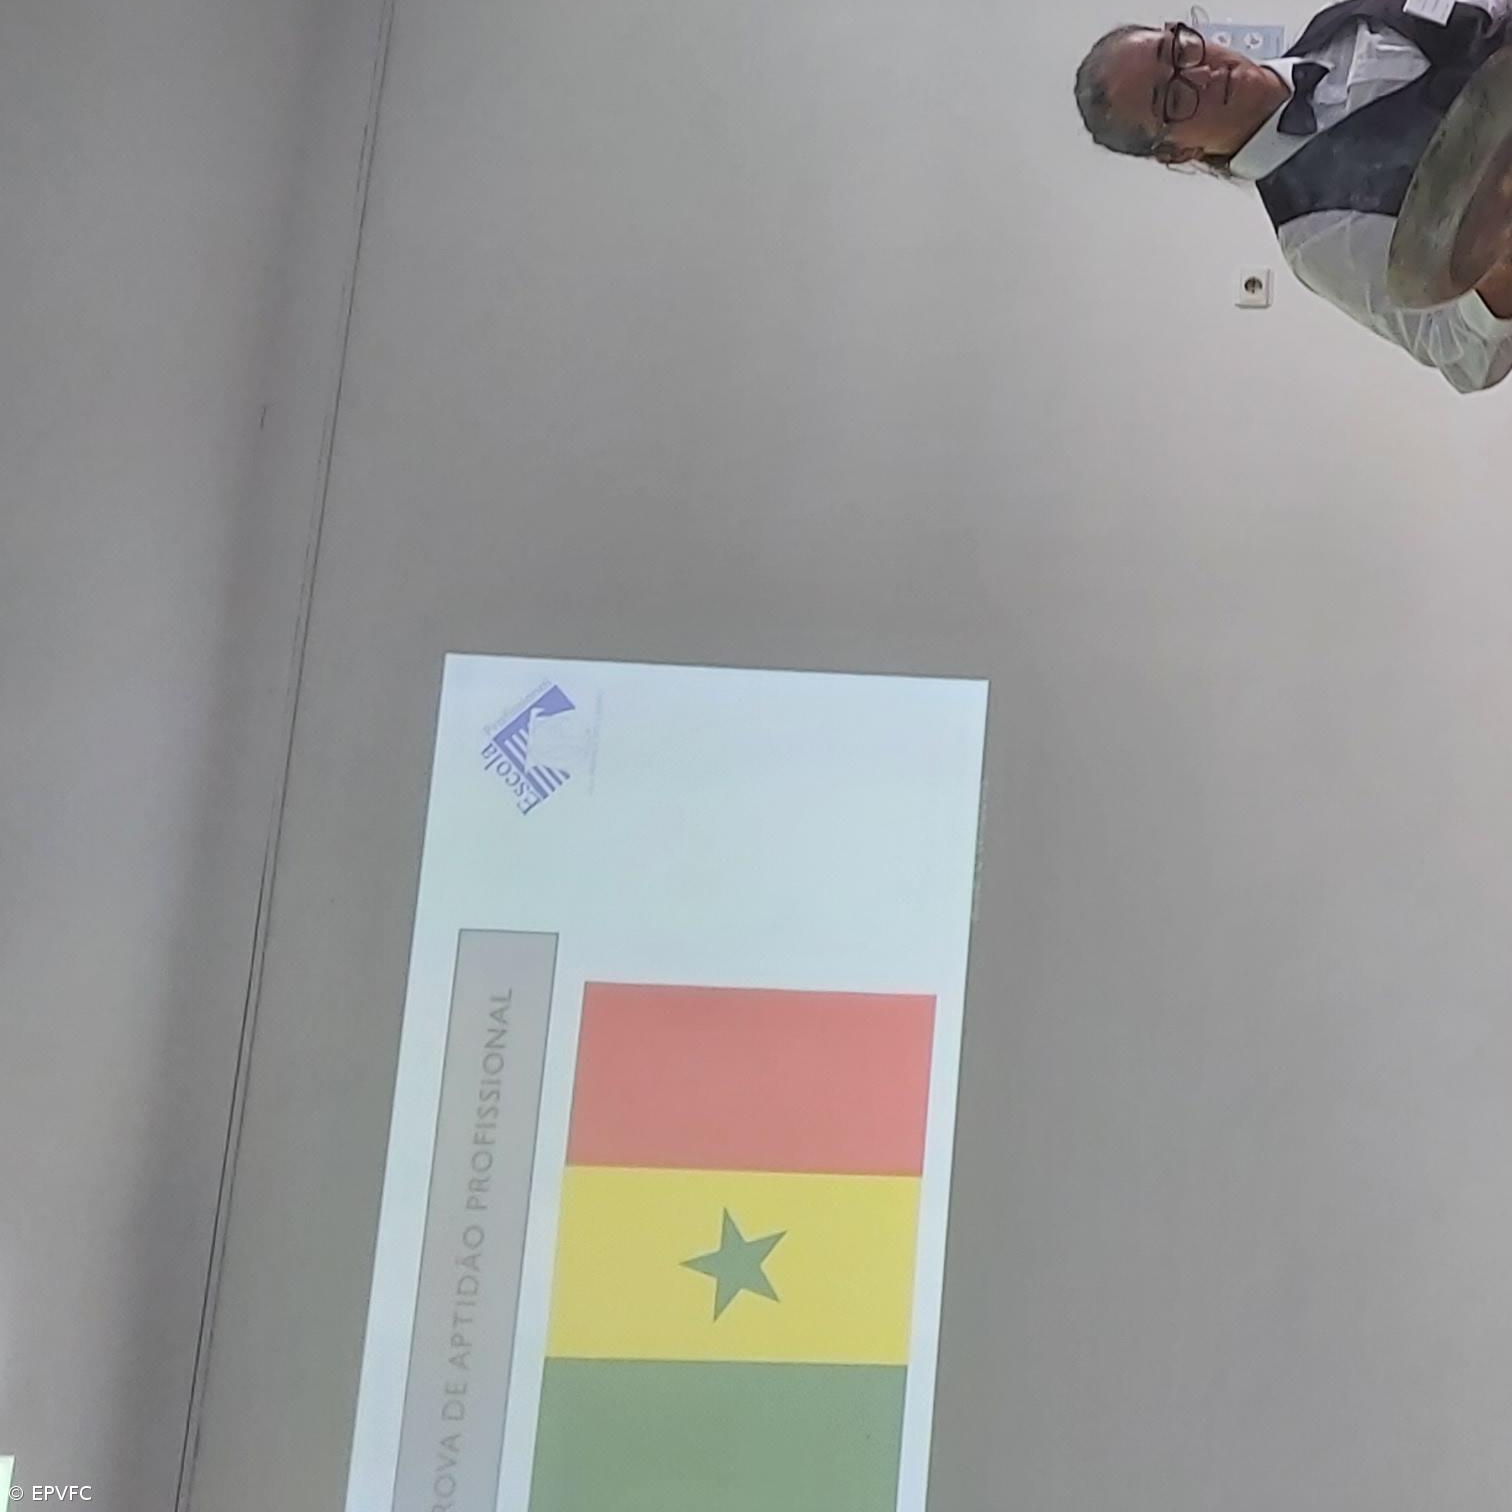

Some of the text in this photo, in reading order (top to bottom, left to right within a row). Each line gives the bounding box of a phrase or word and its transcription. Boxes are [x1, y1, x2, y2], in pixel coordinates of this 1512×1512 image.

[481, 743, 541, 814] Escola
[464, 987, 513, 1212] PROFISSIONAL
[447, 1224, 486, 1371] APTIDÃO
[440, 1381, 469, 1421] DE
